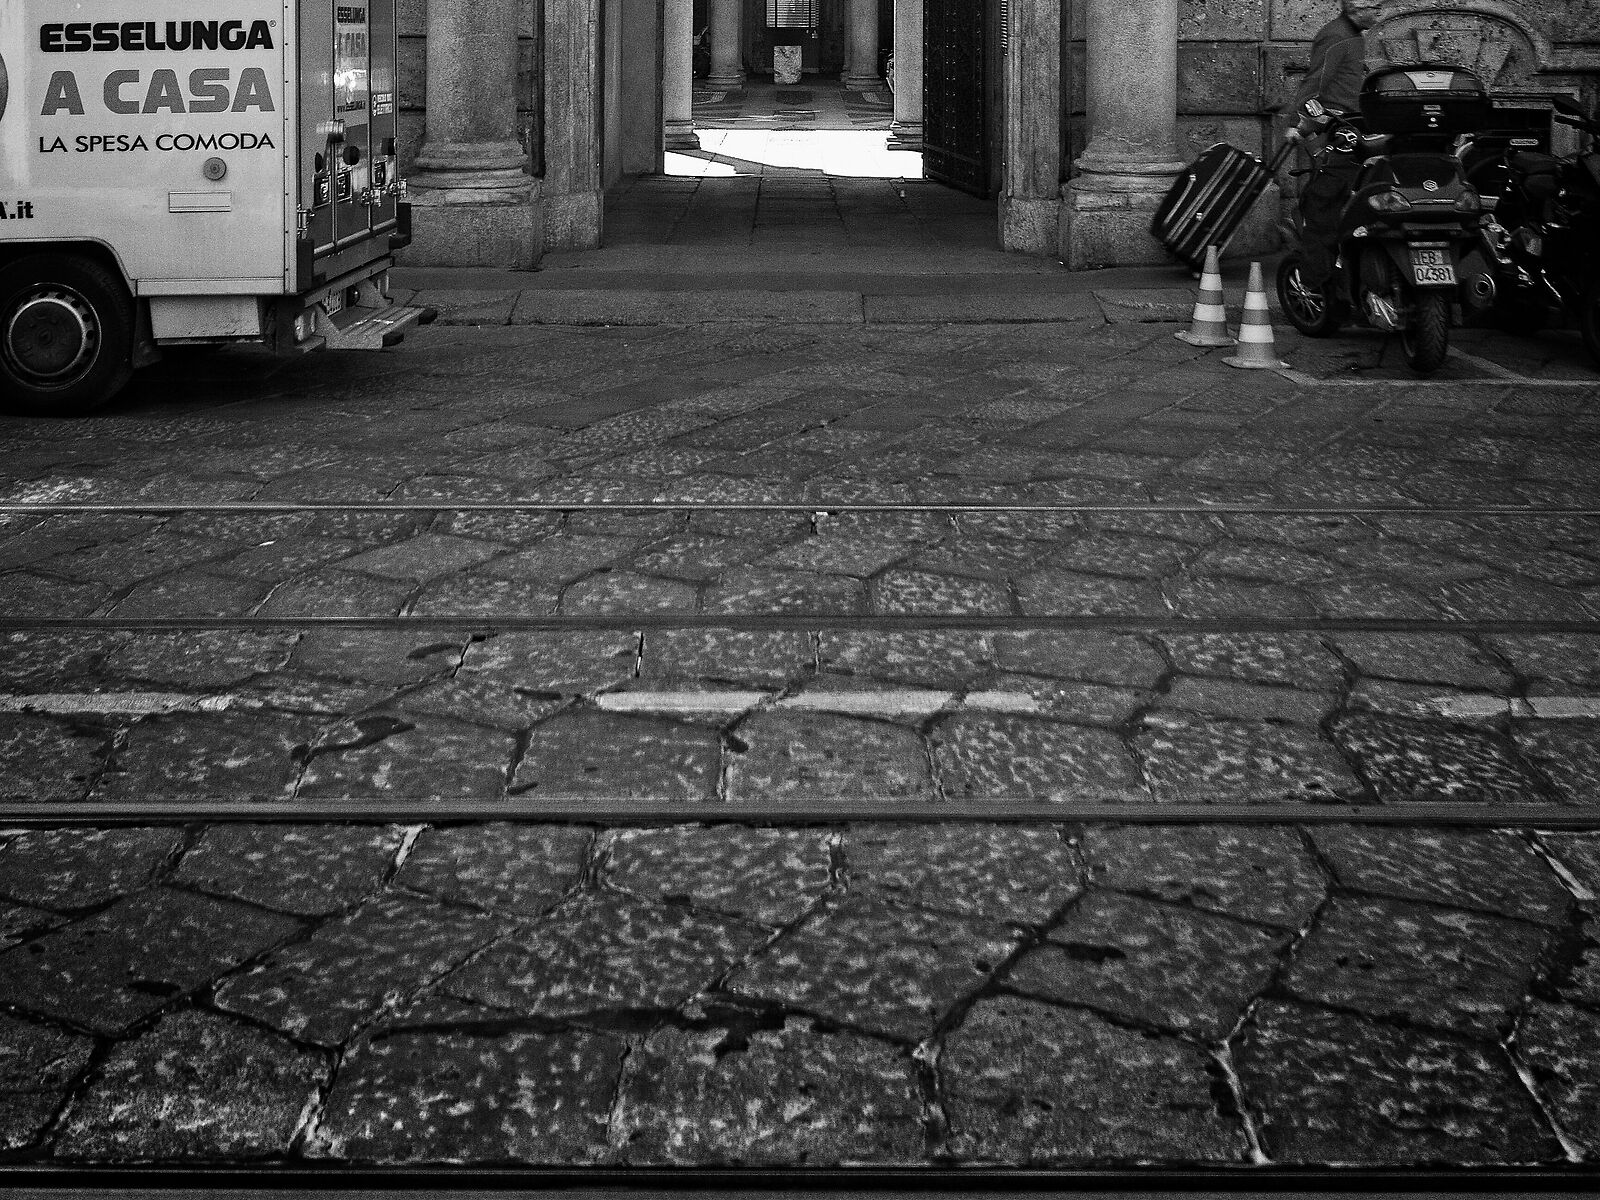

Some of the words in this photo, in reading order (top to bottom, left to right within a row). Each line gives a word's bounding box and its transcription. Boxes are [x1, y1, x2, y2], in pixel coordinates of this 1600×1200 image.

[40, 20, 275, 52] ESSELUNGA
[40, 70, 85, 116] A
[103, 67, 276, 115] CASA
[40, 136, 68, 153] LA
[75, 134, 149, 153] SPESA
[155, 132, 275, 151] COMODA
